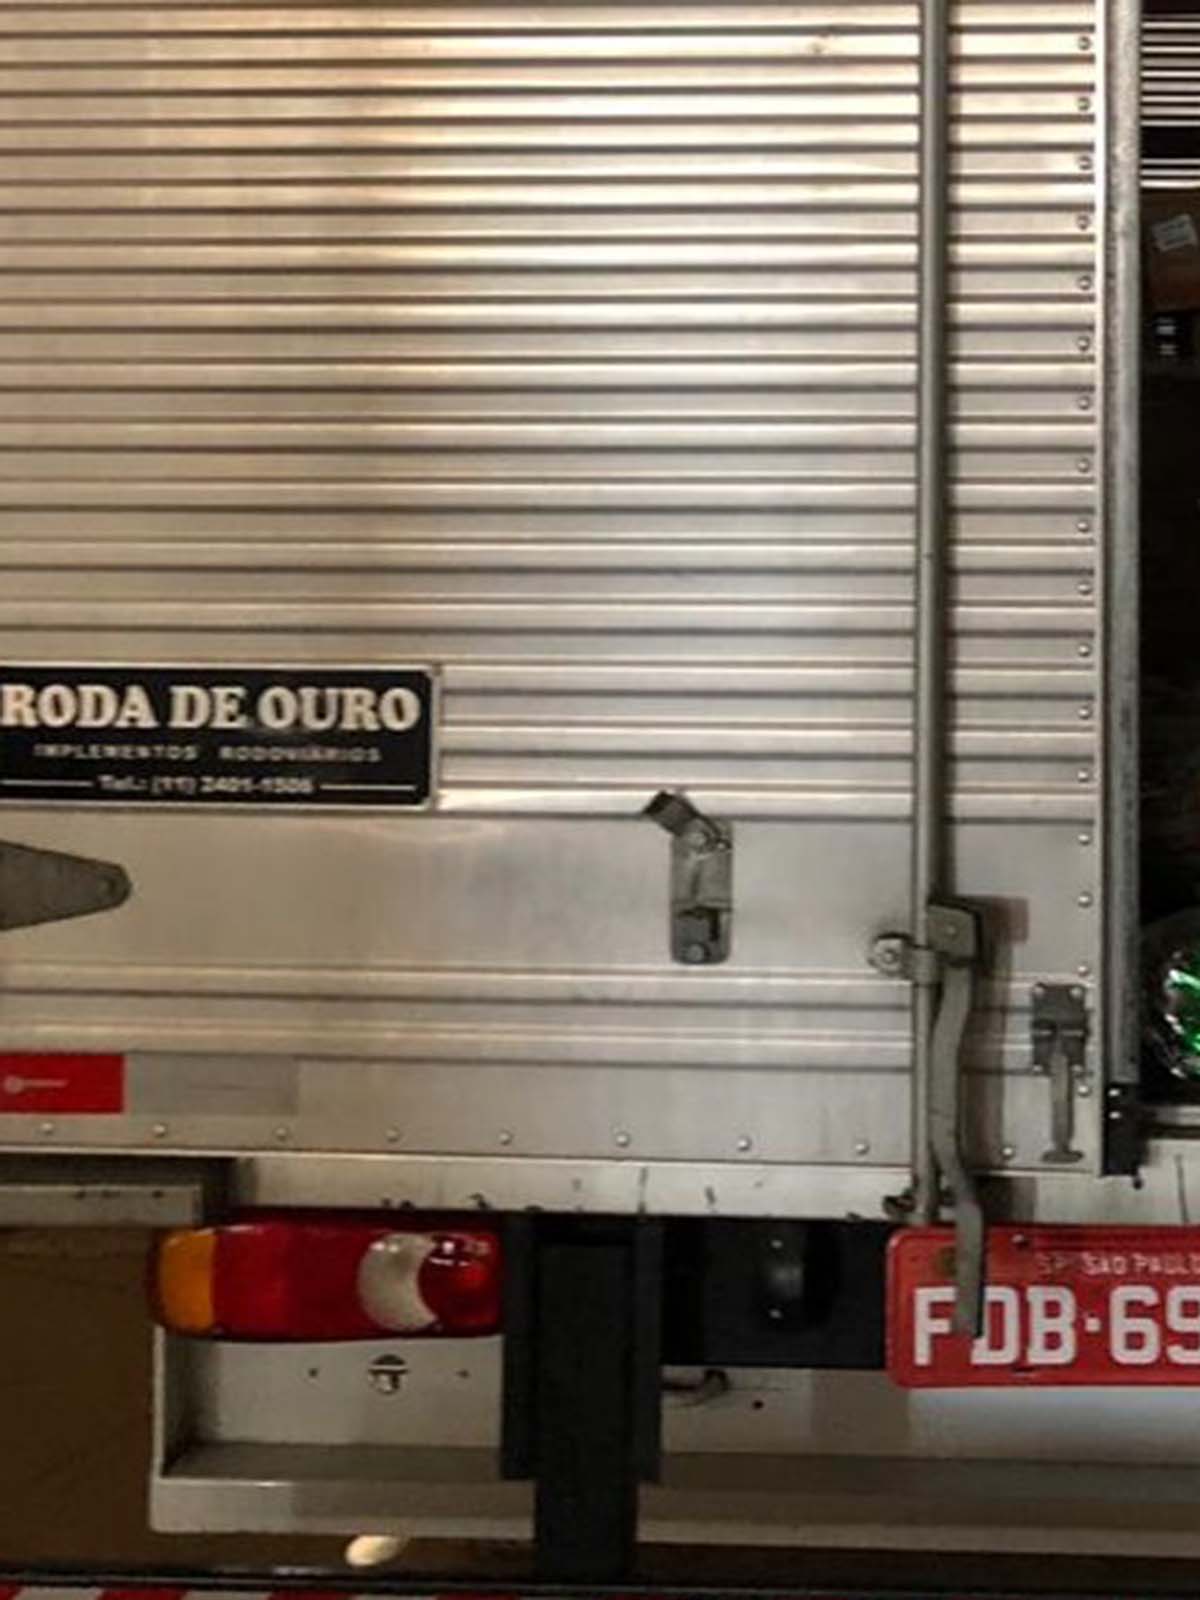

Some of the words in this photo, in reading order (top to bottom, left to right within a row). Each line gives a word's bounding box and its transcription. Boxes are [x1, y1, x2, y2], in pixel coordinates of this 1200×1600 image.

[0, 684, 159, 728] RODA
[168, 685, 250, 728] DE
[256, 686, 421, 731] OURO
